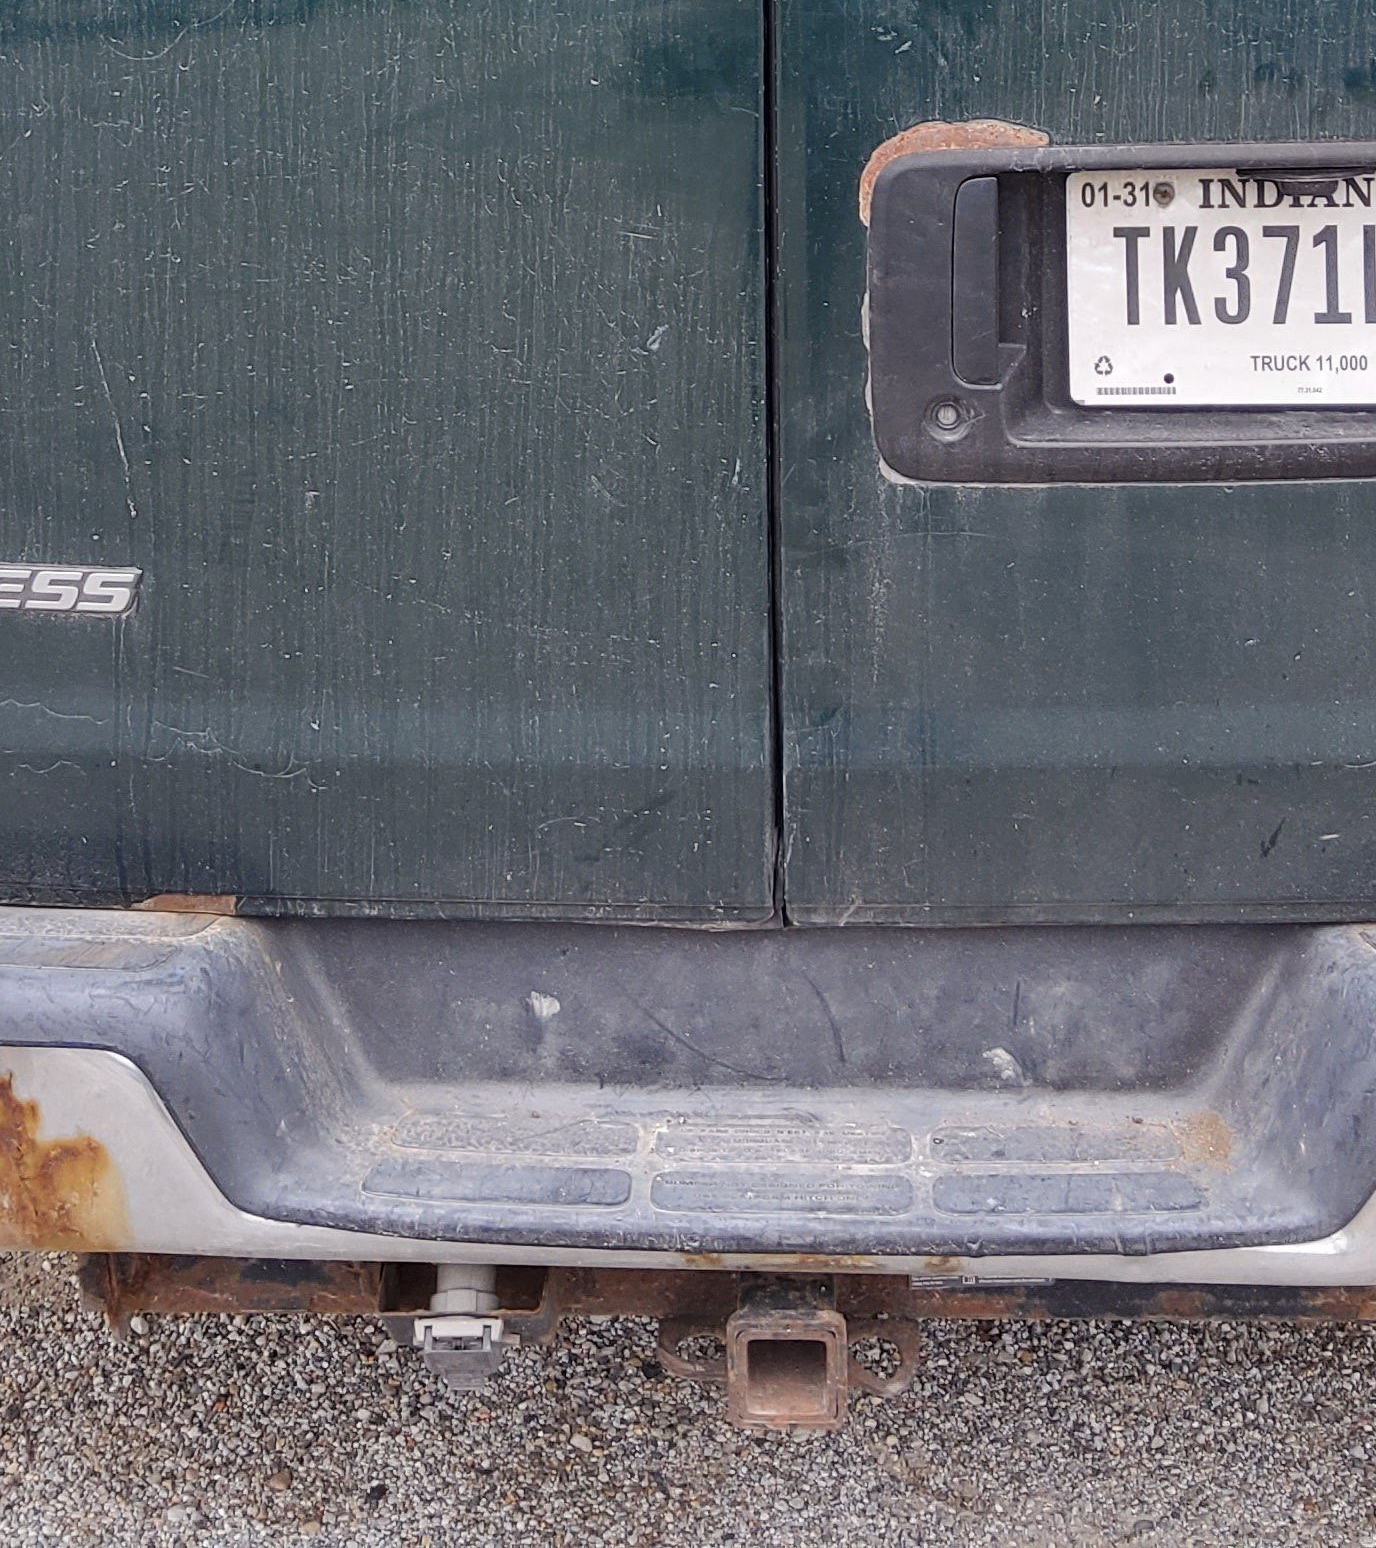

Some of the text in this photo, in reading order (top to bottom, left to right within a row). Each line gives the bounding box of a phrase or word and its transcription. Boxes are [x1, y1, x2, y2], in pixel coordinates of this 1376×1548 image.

[1080, 181, 1151, 208] 01-31
[1250, 355, 1369, 374] TRUCK 11,000
